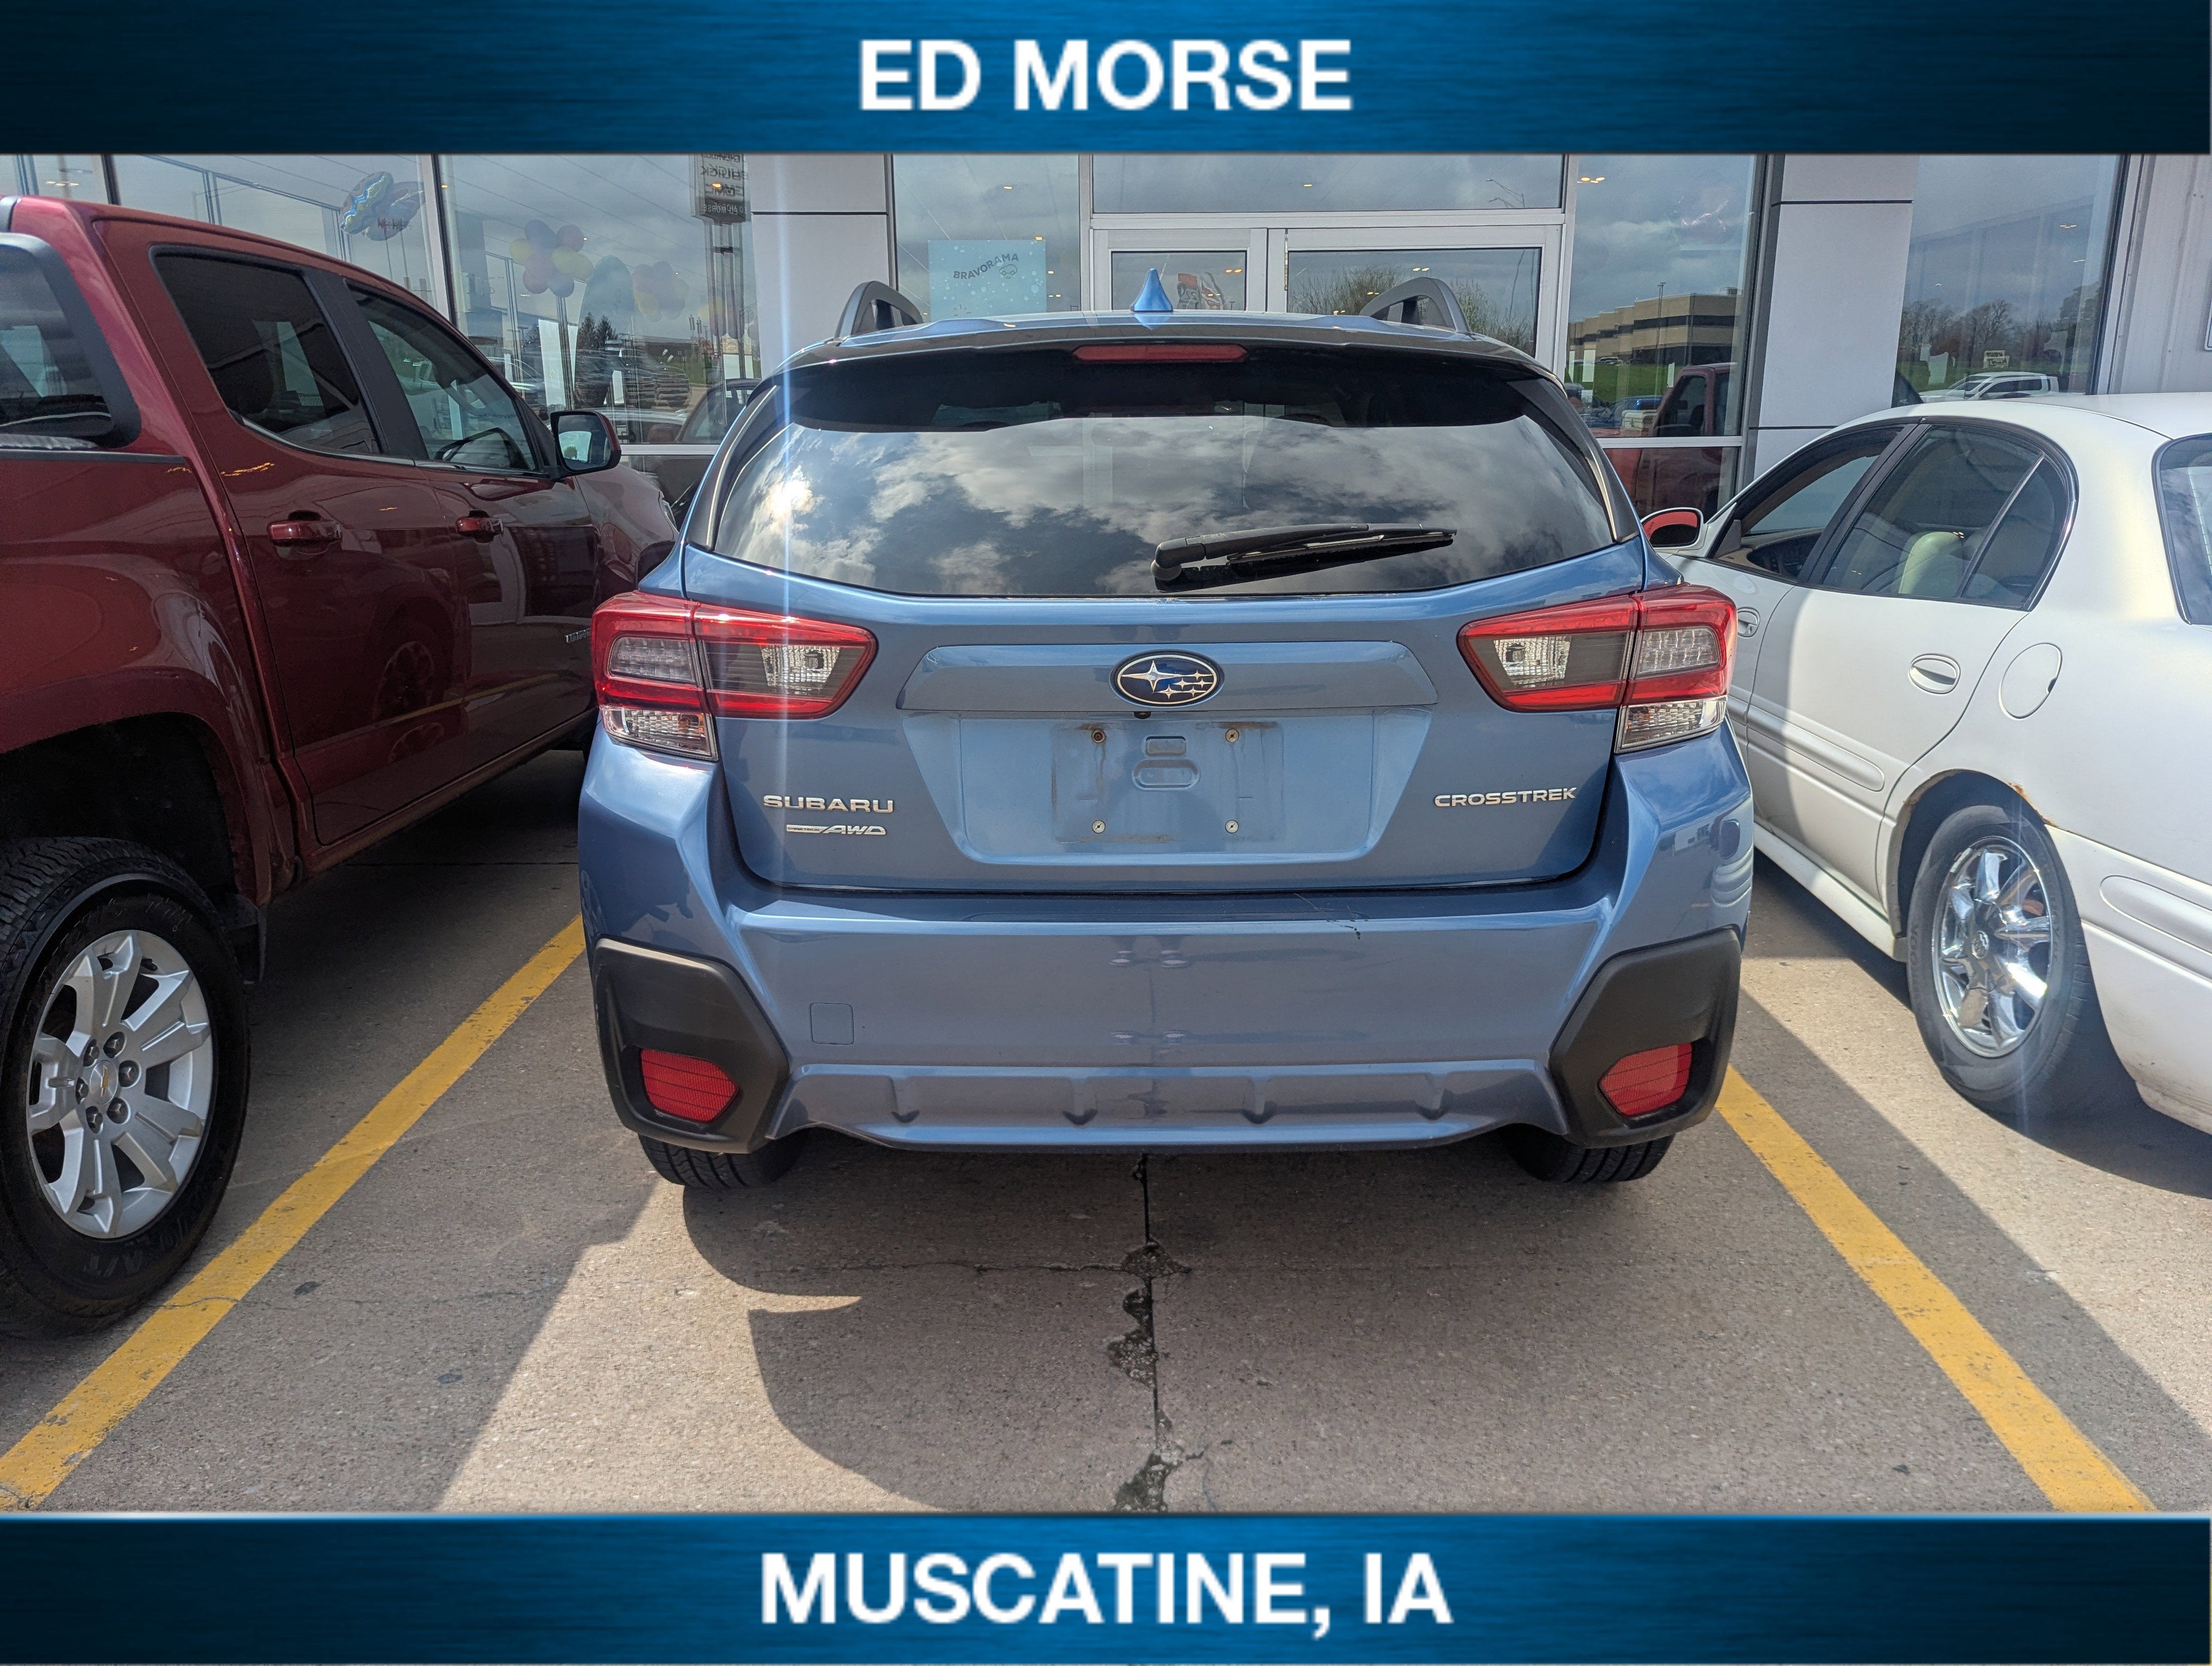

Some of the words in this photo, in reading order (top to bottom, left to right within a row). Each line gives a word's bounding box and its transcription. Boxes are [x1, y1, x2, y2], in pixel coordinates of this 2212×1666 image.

[953, 253, 1019, 280] BRAVORAMA
[763, 795, 893, 813] SUBARU
[1434, 787, 1578, 806] CROSSTREK
[823, 825, 886, 835] AWD
